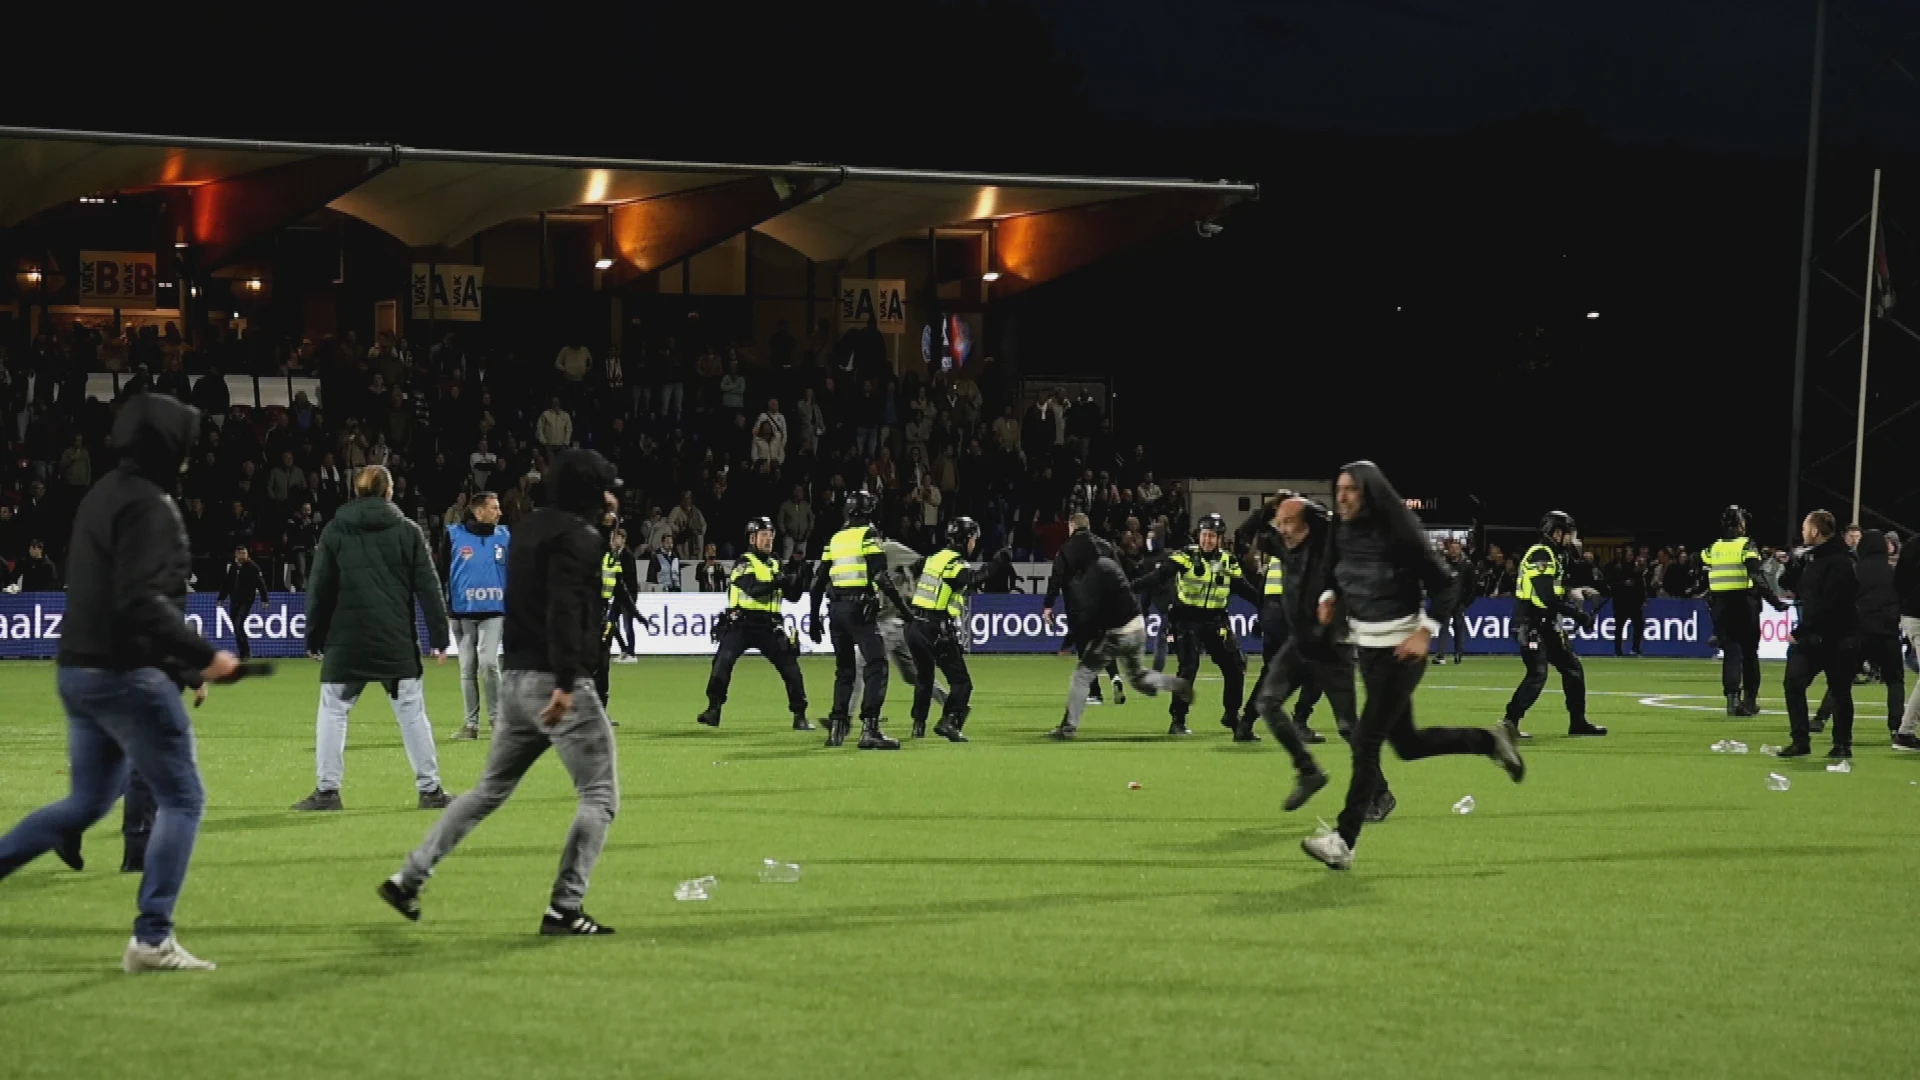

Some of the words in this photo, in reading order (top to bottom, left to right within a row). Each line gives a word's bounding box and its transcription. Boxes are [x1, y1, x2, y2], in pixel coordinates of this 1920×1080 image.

[96, 261, 119, 294] B
[135, 263, 154, 296] B
[414, 274, 426, 306] VAK
[427, 275, 449, 306] A
[453, 274, 462, 306] VAK
[462, 275, 479, 308] A
[843, 288, 855, 320] VAK
[855, 288, 877, 321] A
[879, 288, 888, 320] VAK
[888, 288, 904, 321] A
